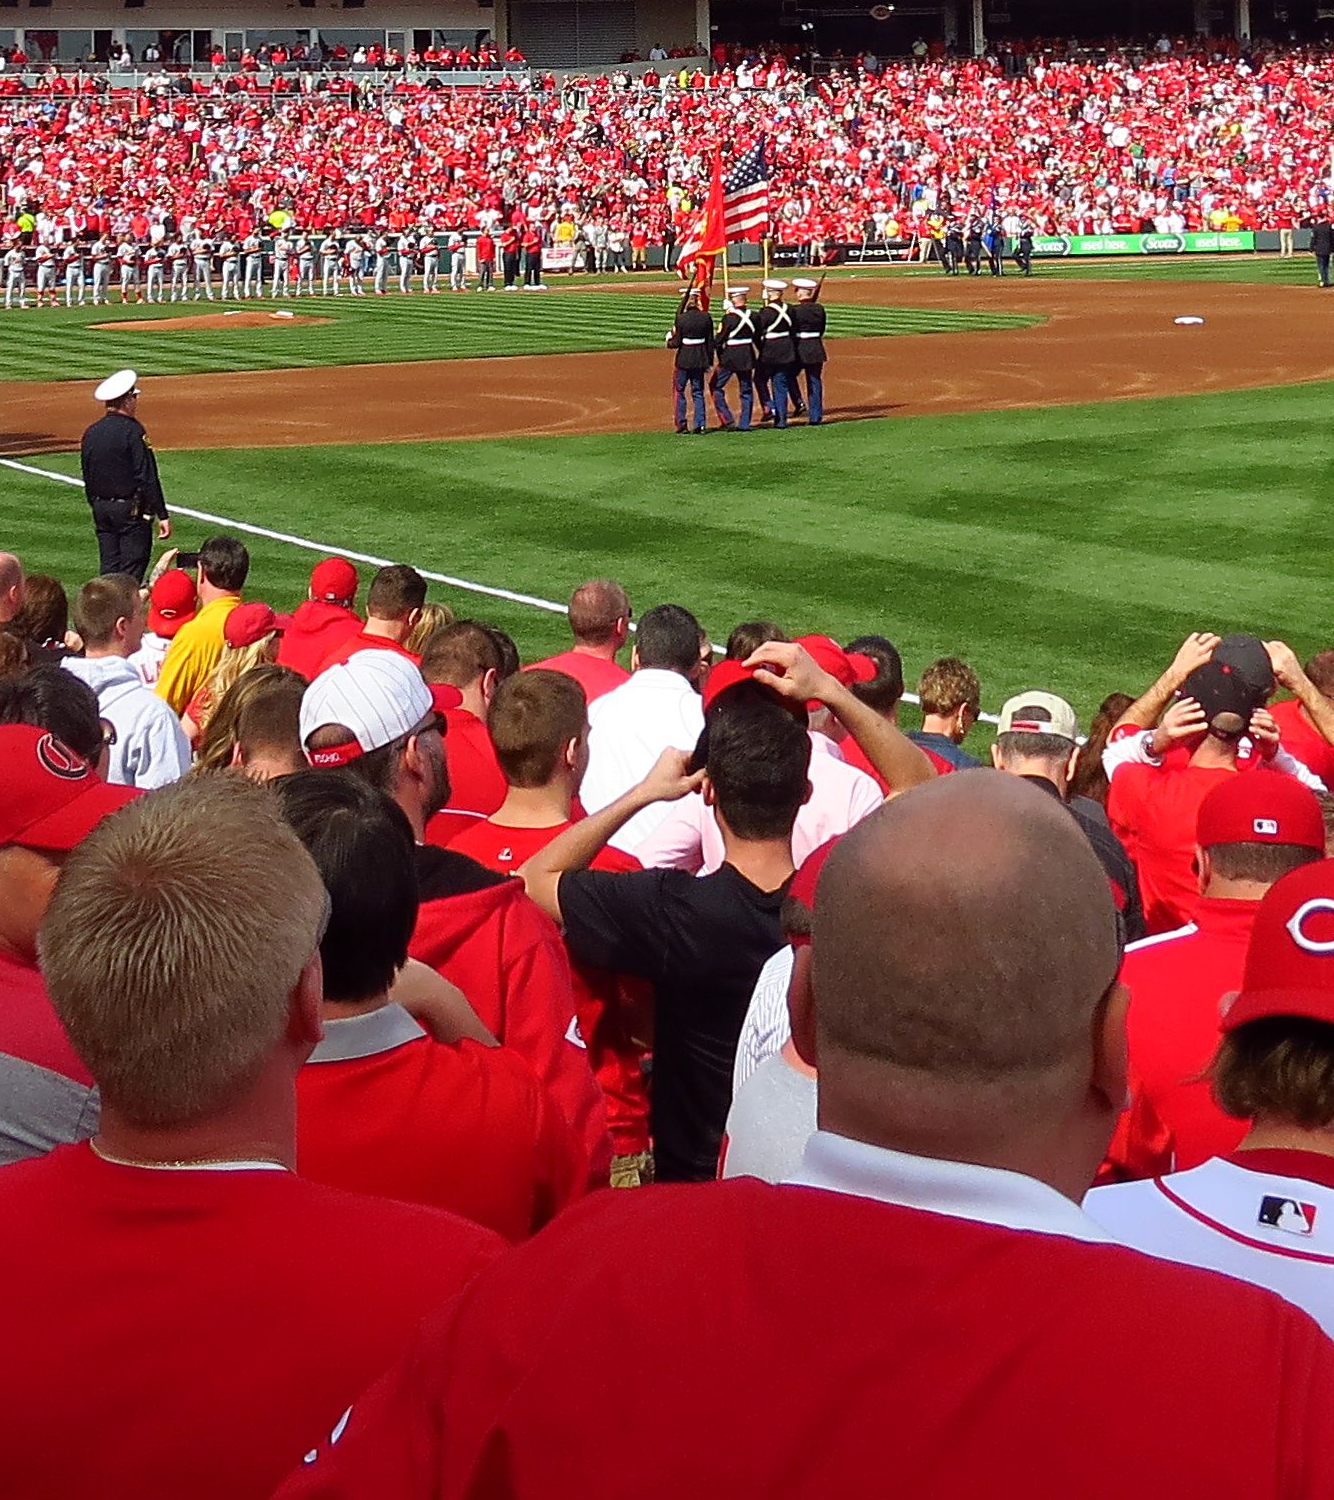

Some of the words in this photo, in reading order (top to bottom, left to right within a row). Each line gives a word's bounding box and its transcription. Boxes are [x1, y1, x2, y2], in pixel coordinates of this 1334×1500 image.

[1080, 238, 1104, 251] used
[1105, 238, 1129, 250] here.
[1145, 238, 1178, 251] Scotts
[1194, 237, 1218, 249] used
[1219, 236, 1243, 248] here.
[848, 249, 909, 257] DODGE
